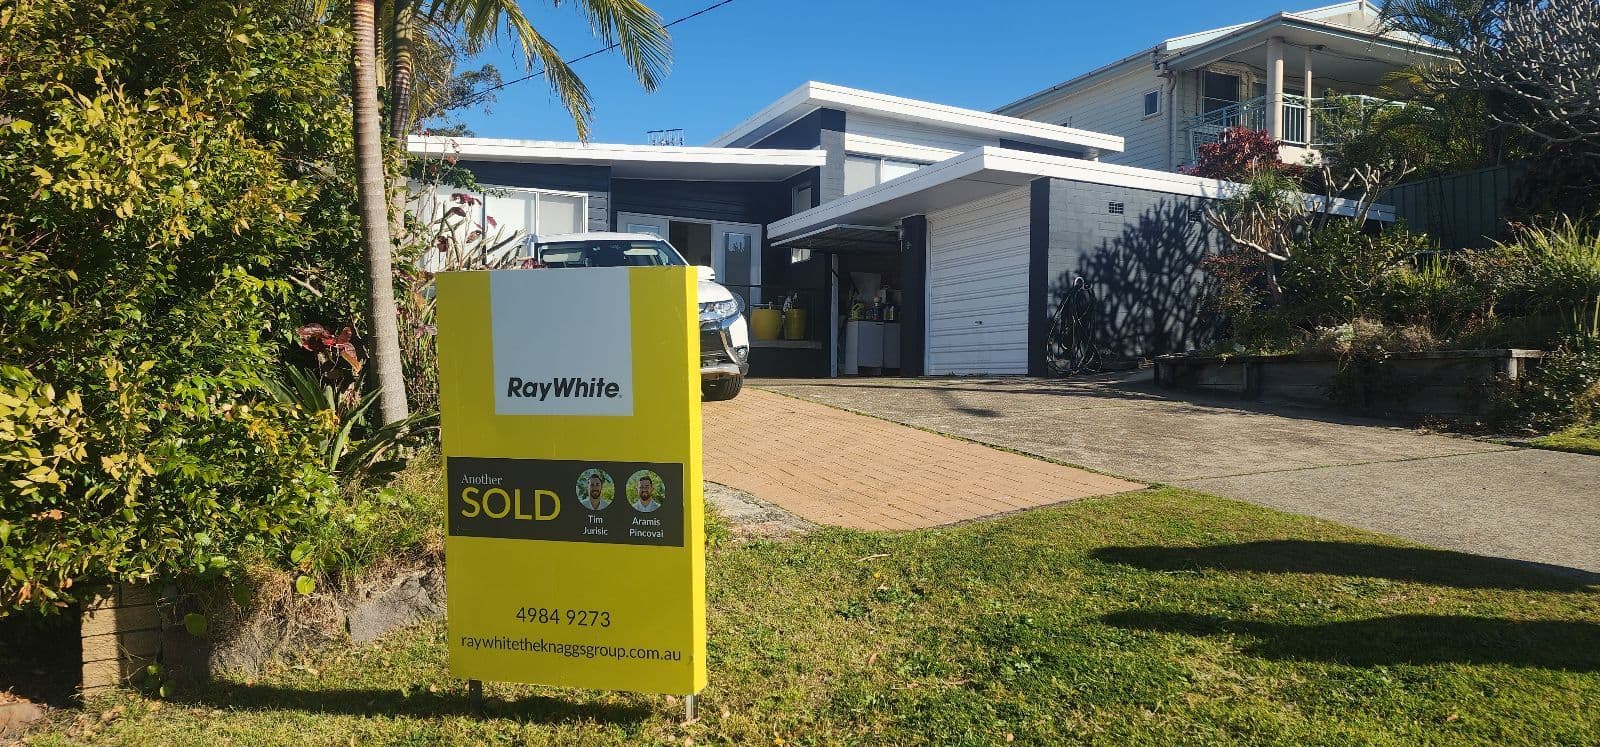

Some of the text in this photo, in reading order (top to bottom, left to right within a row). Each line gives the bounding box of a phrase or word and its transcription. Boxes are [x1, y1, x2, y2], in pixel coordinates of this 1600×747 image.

[461, 473, 503, 486] Another
[461, 487, 561, 521] SOLD
[588, 515, 603, 524] Tim
[632, 517, 661, 526] Aramis
[582, 526, 609, 536] Jurisic
[629, 528, 664, 538] Pincovai
[516, 607, 611, 628] 4984 9273
[461, 635, 682, 662] raywhitetheknaggsgroup.com.au
